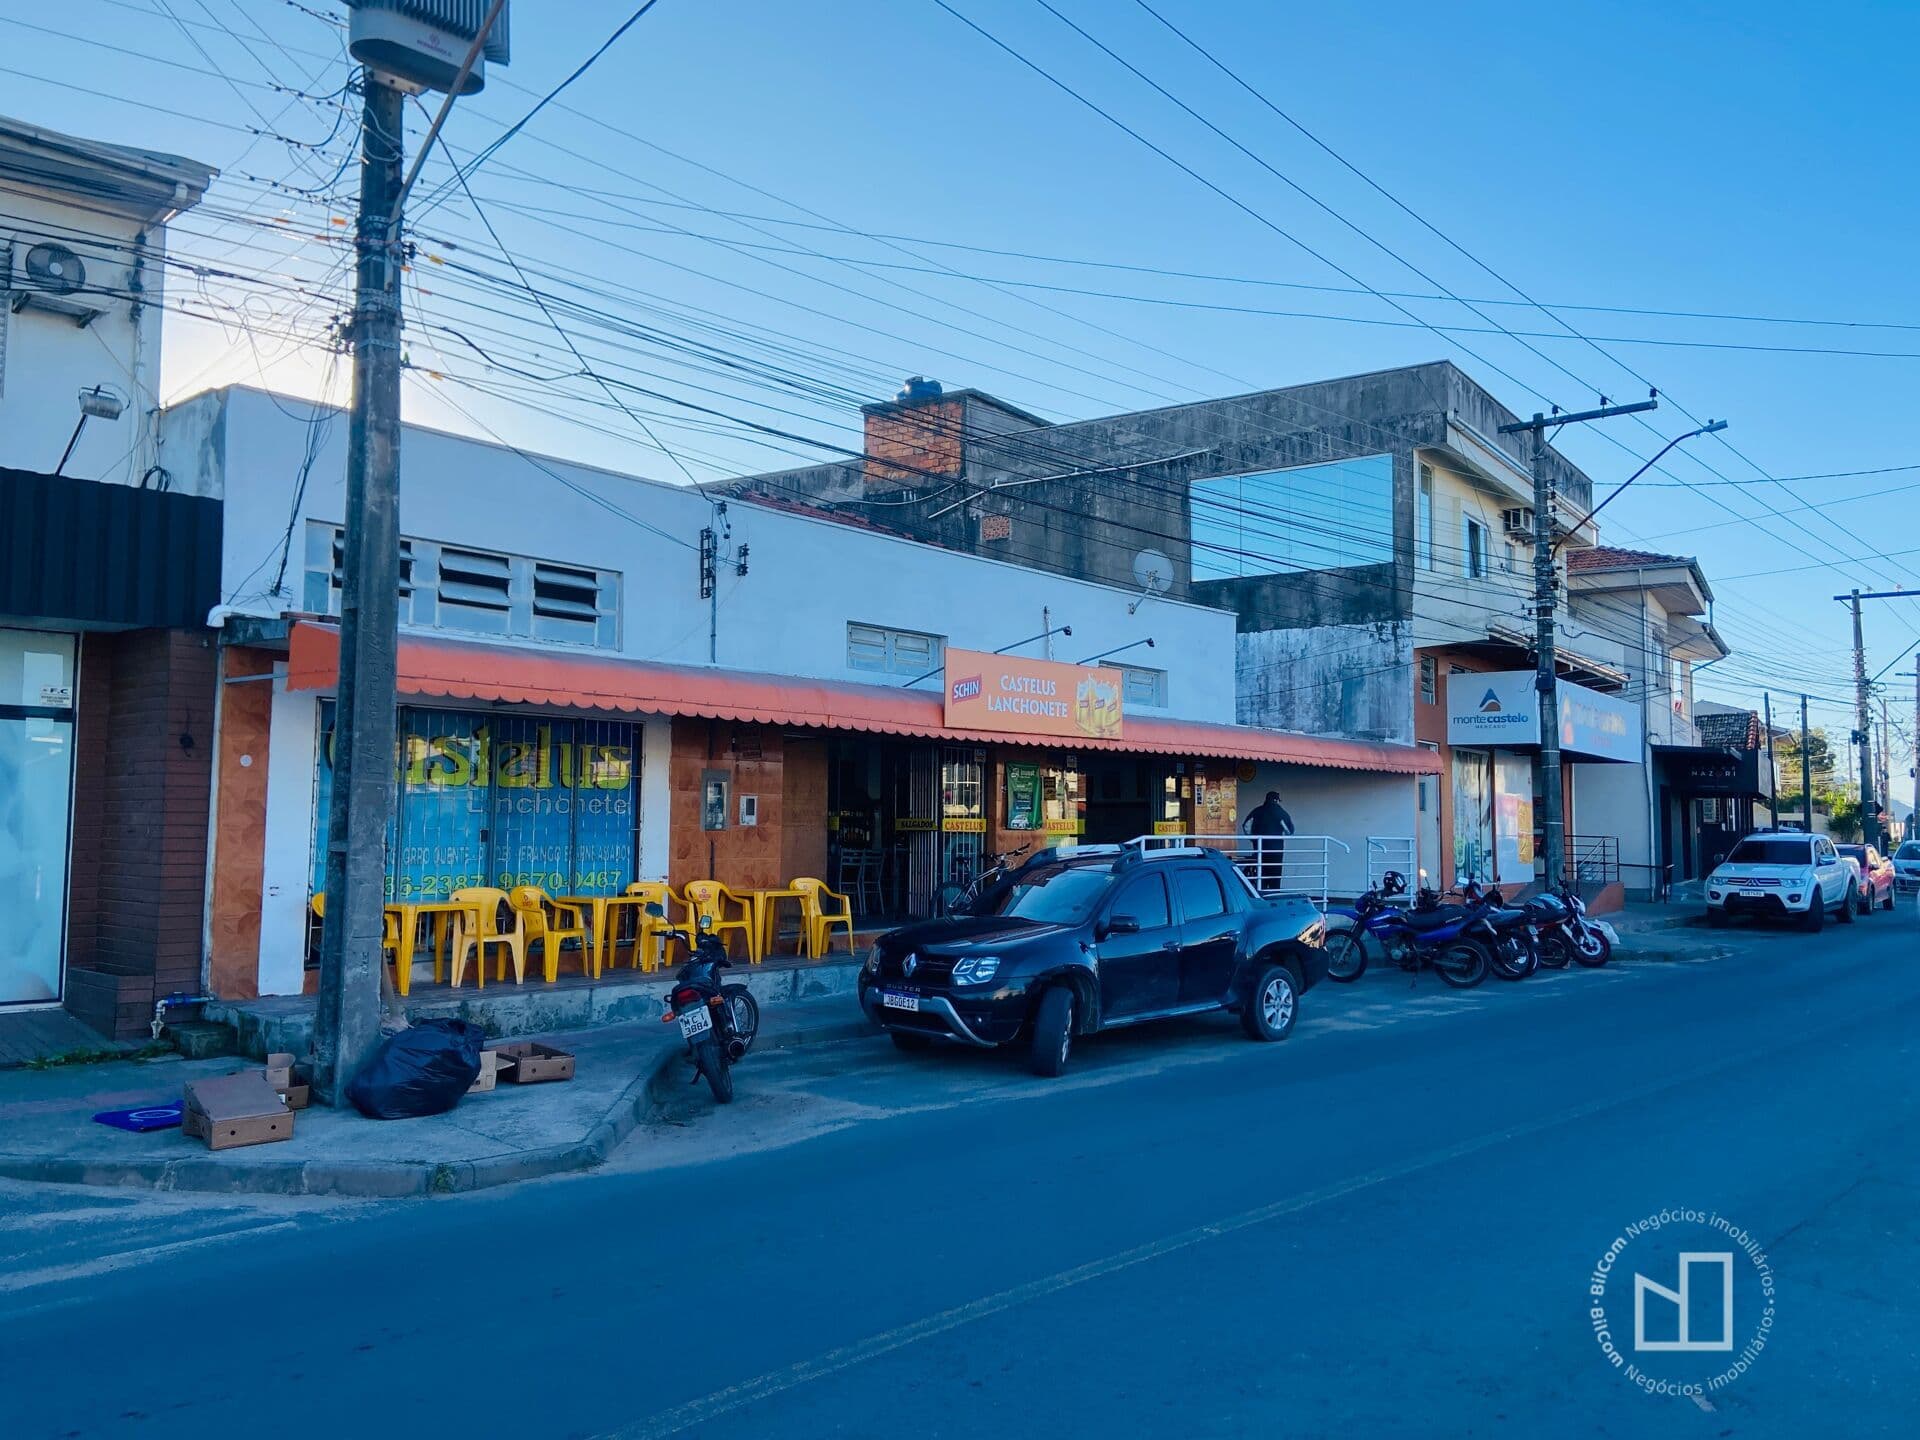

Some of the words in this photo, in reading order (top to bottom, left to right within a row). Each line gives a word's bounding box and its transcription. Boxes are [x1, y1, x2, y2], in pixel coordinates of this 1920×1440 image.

[953, 680, 980, 699] SCHIN
[1000, 674, 1056, 696] CASTELUS
[987, 695, 1068, 718] LANCHONETE
[327, 722, 631, 790] astelus
[466, 790, 629, 816] Lnchonete
[945, 821, 984, 831] CASTELUS
[1047, 821, 1076, 831] ASTELUS
